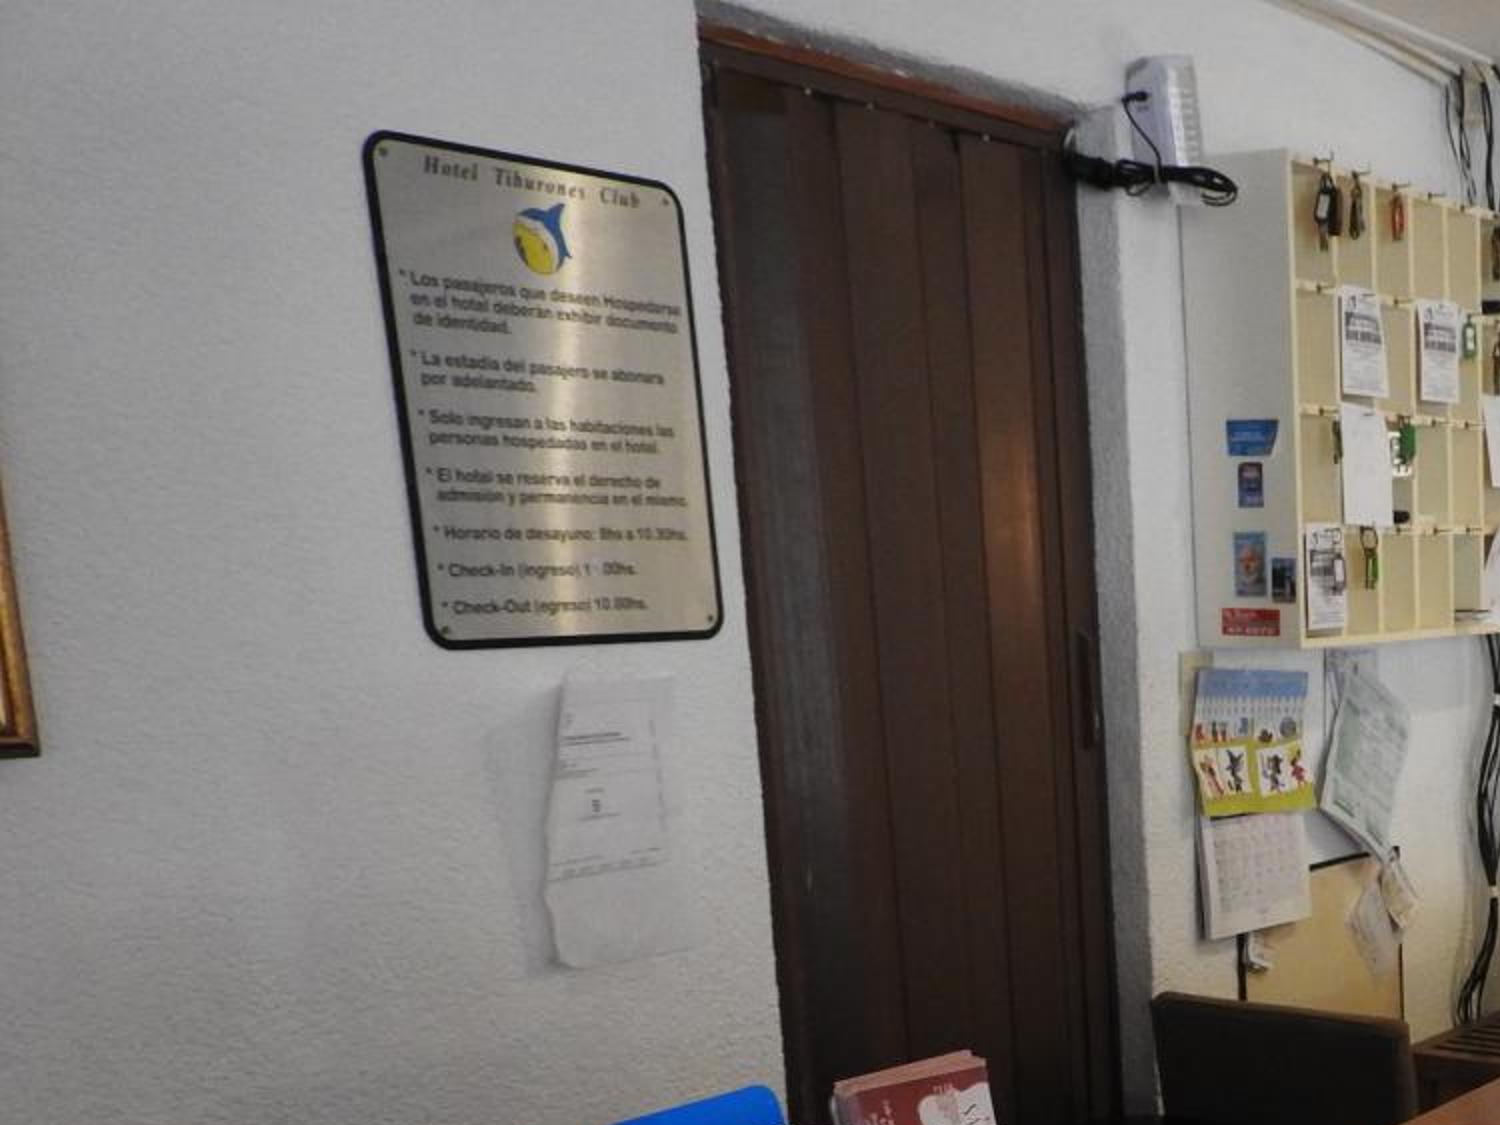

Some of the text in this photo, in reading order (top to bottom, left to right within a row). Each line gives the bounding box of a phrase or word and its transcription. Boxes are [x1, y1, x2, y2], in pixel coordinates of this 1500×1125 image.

[421, 153, 641, 209] Hotel Tiburones Club
[409, 270, 437, 288] Los
[442, 276, 514, 299] pasajeros
[519, 285, 546, 303] que
[409, 294, 430, 306] en
[433, 295, 447, 308] el
[451, 297, 489, 312] hotel
[413, 311, 433, 325] de
[420, 352, 440, 366] La
[503, 359, 526, 374] del
[528, 362, 589, 381] pasajero
[592, 370, 607, 380] se
[420, 373, 447, 388] por
[467, 413, 529, 432] ingresan
[533, 420, 541, 430] a
[545, 418, 566, 431] las
[569, 419, 653, 436] habitaciones
[655, 425, 674, 438] las
[428, 432, 498, 448] personas
[502, 434, 586, 452] hospedadas
[590, 441, 605, 451] en
[610, 440, 622, 452] el
[436, 468, 660, 489] El hotel se reserva el derecho de
[507, 494, 515, 506] y
[612, 495, 627, 505] en
[630, 494, 642, 505] el
[443, 525, 500, 539] Horario
[503, 526, 521, 539] de
[626, 530, 633, 540] a
